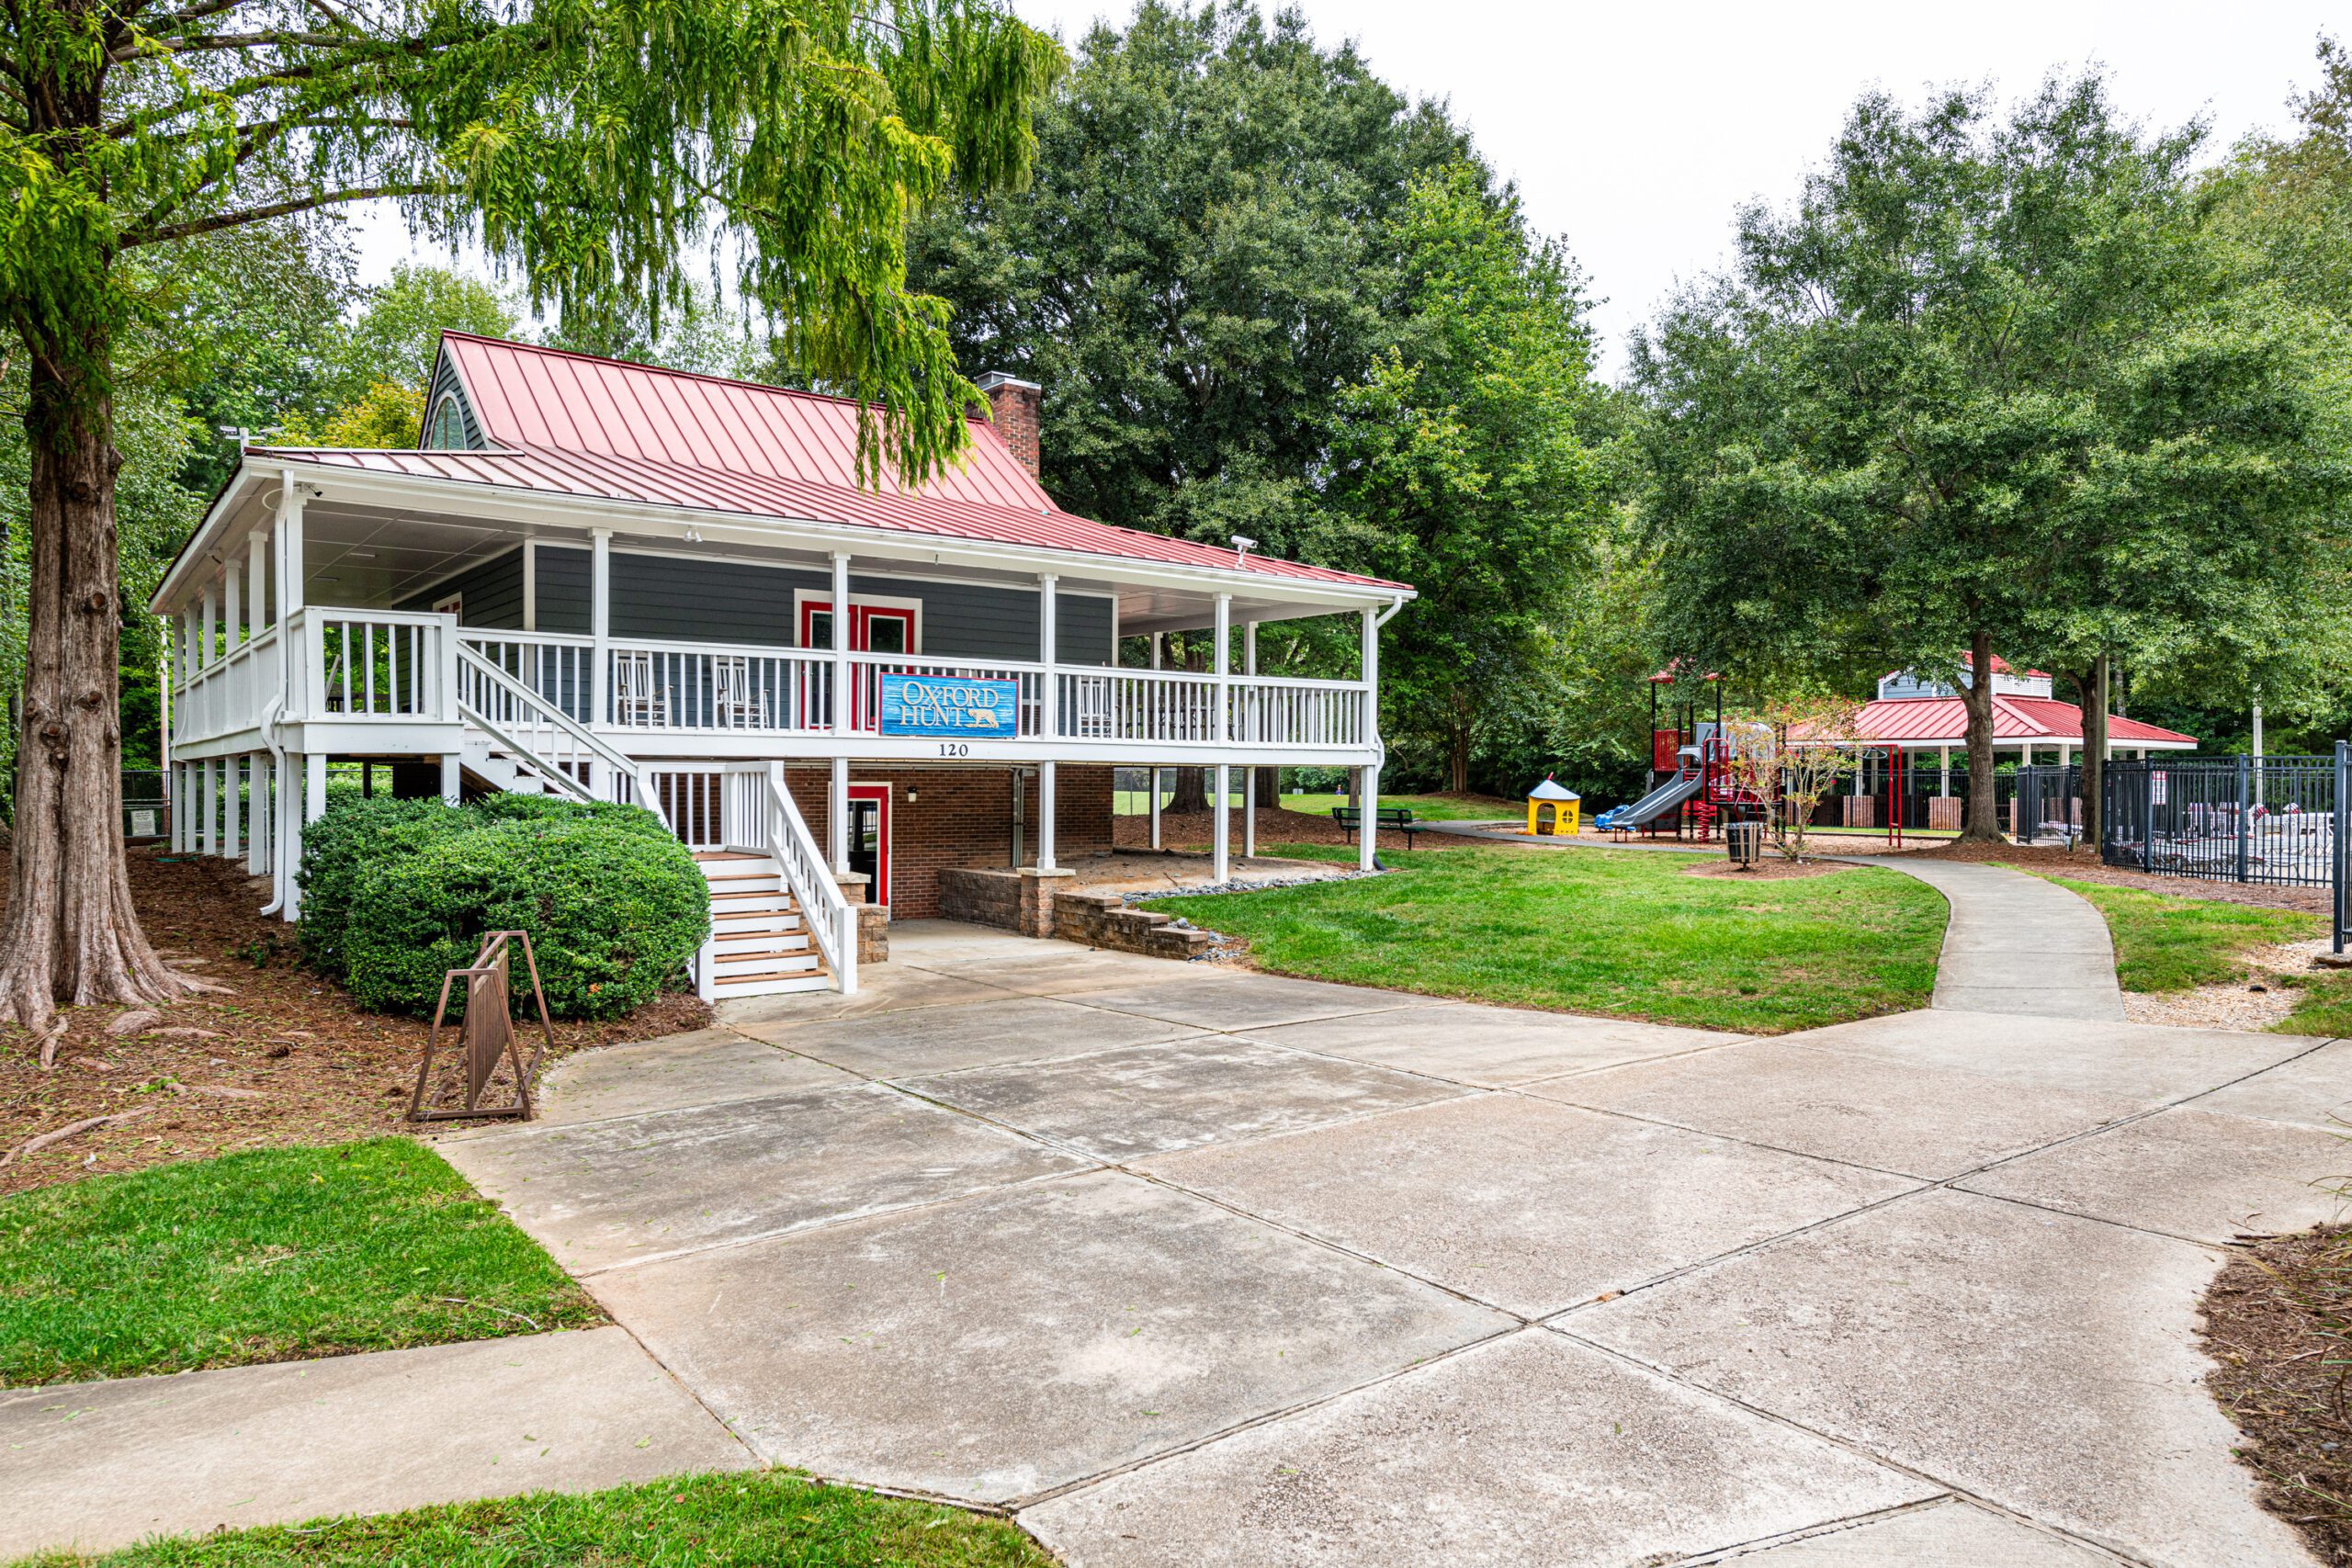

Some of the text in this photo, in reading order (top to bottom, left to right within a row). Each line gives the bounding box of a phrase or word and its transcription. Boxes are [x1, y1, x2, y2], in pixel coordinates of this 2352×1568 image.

[901, 681, 1000, 709] OXFORD
[899, 705, 966, 727] HUNT
[939, 743, 969, 757] 120
